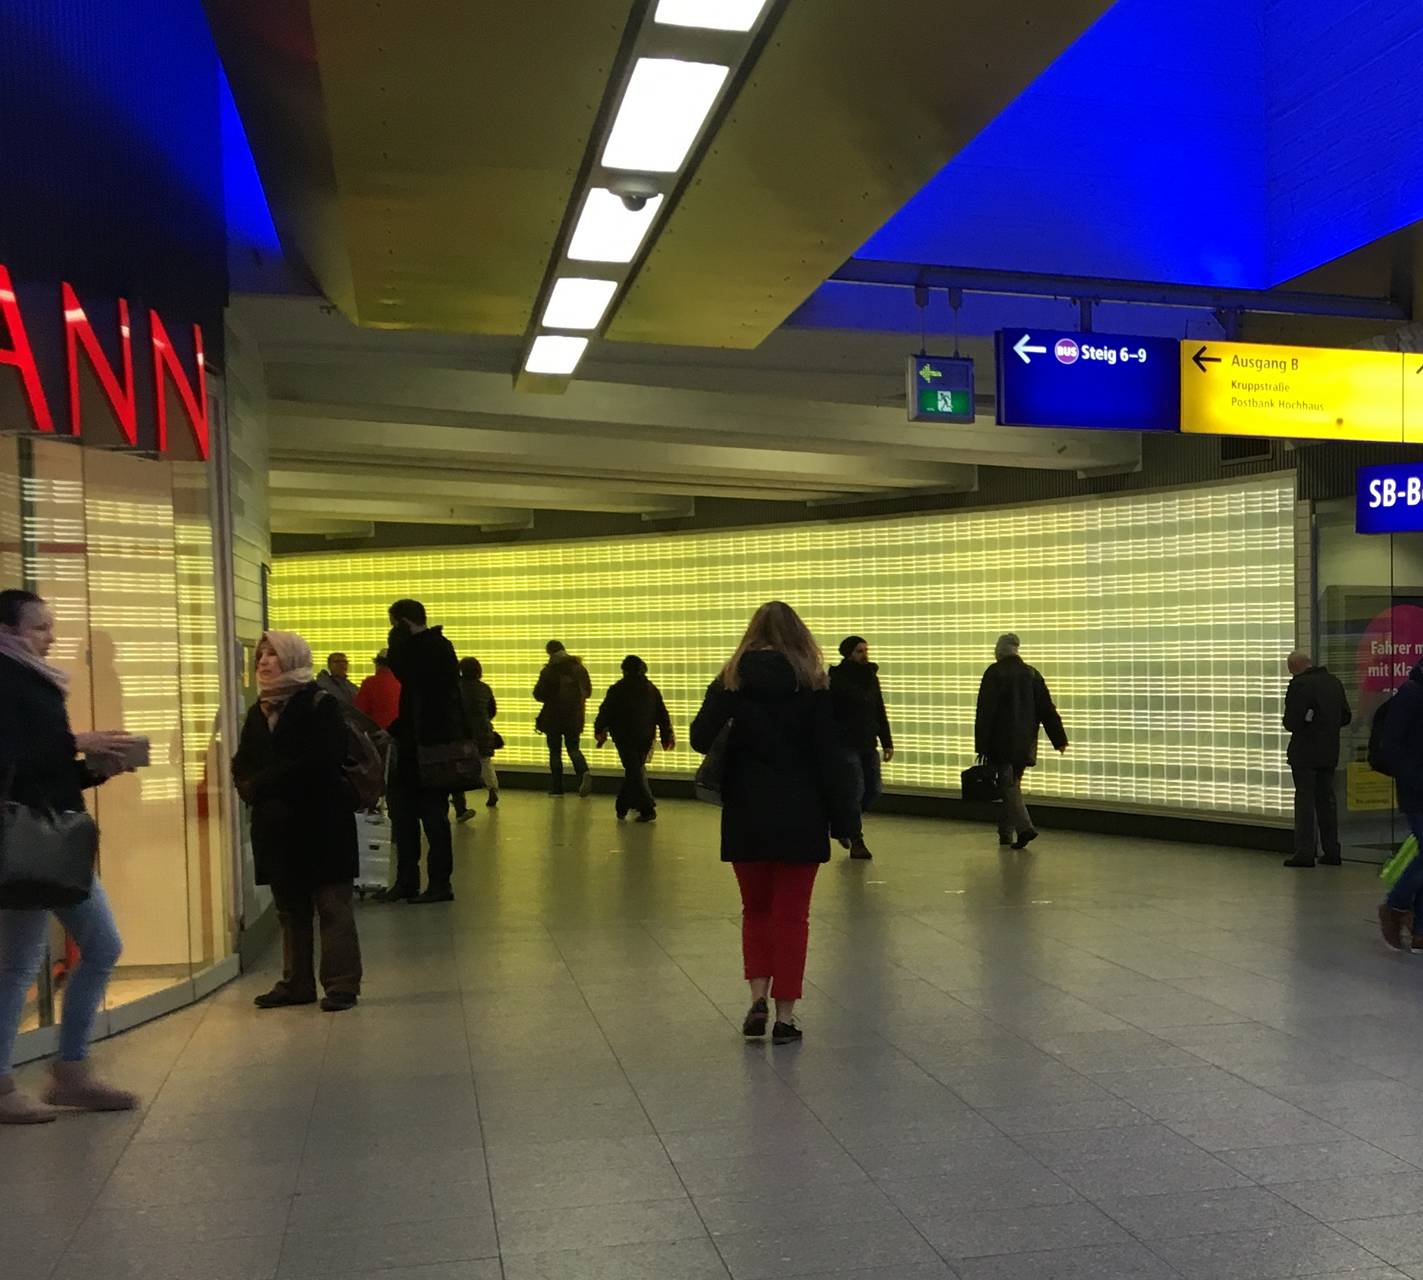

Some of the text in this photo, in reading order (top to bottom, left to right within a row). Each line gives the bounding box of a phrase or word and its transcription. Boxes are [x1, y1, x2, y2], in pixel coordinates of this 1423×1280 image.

[1081, 345, 1117, 365] Steig
[1231, 354, 1300, 373] Ausgang B
[1231, 380, 1290, 393] Kruppstraße
[1231, 397, 1325, 412] Postbank Hochhaus
[1370, 640, 1412, 655] Fahrer
[1367, 661, 1390, 677] mit
